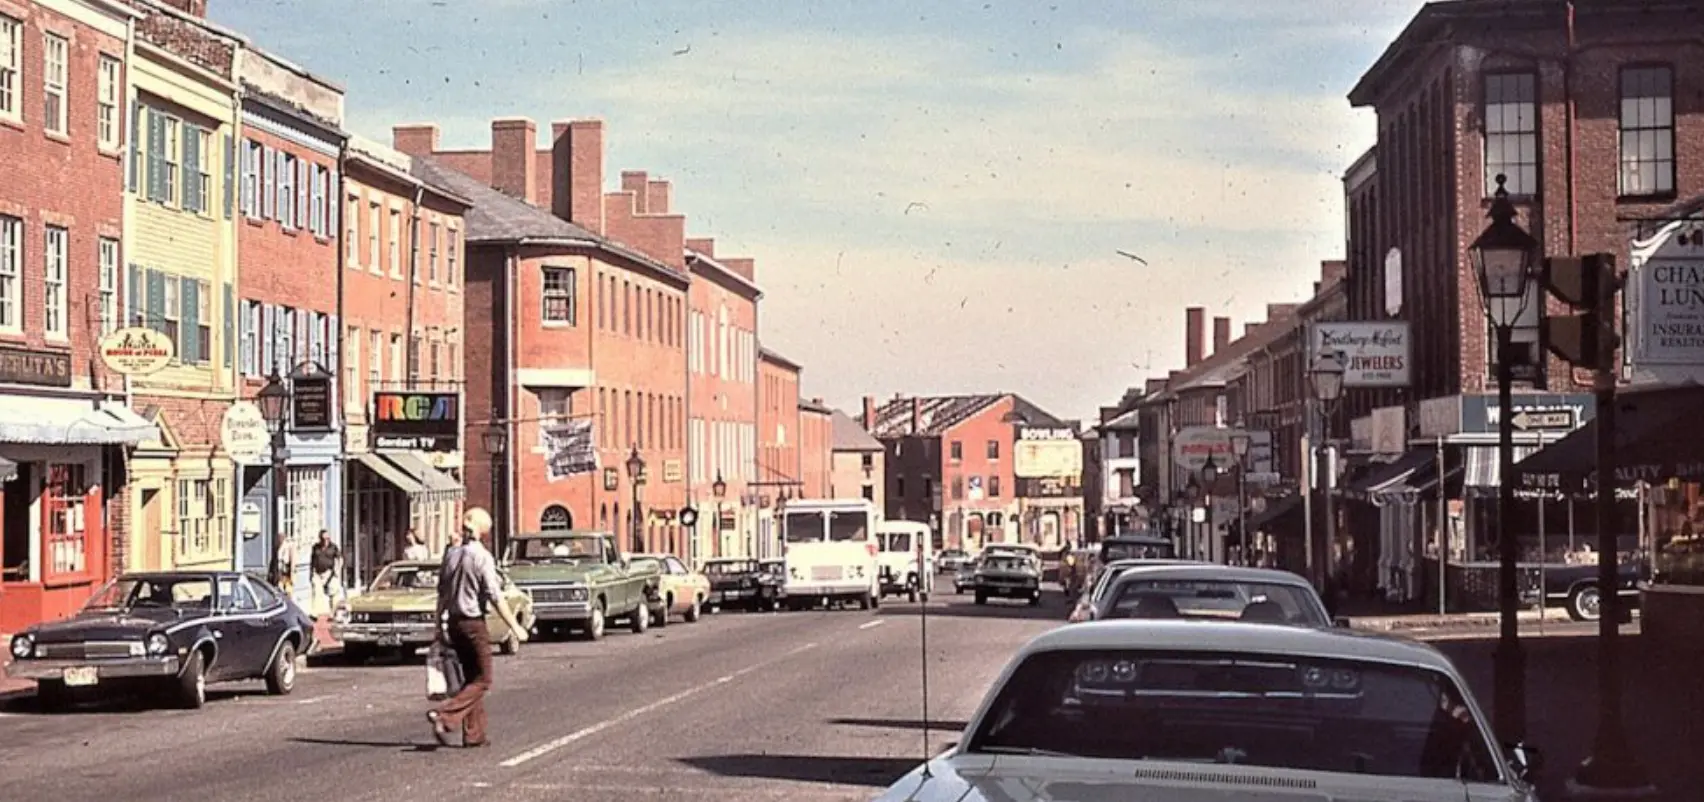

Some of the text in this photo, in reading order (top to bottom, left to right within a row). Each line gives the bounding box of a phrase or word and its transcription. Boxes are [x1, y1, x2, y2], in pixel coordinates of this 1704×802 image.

[1654, 266, 1704, 283] CHA
[1350, 355, 1404, 371] JEWELERS
[378, 395, 456, 421] RCA
[1548, 414, 1565, 424] WAY
[1021, 428, 1074, 440] BOWLING
[420, 436, 436, 449] TV
